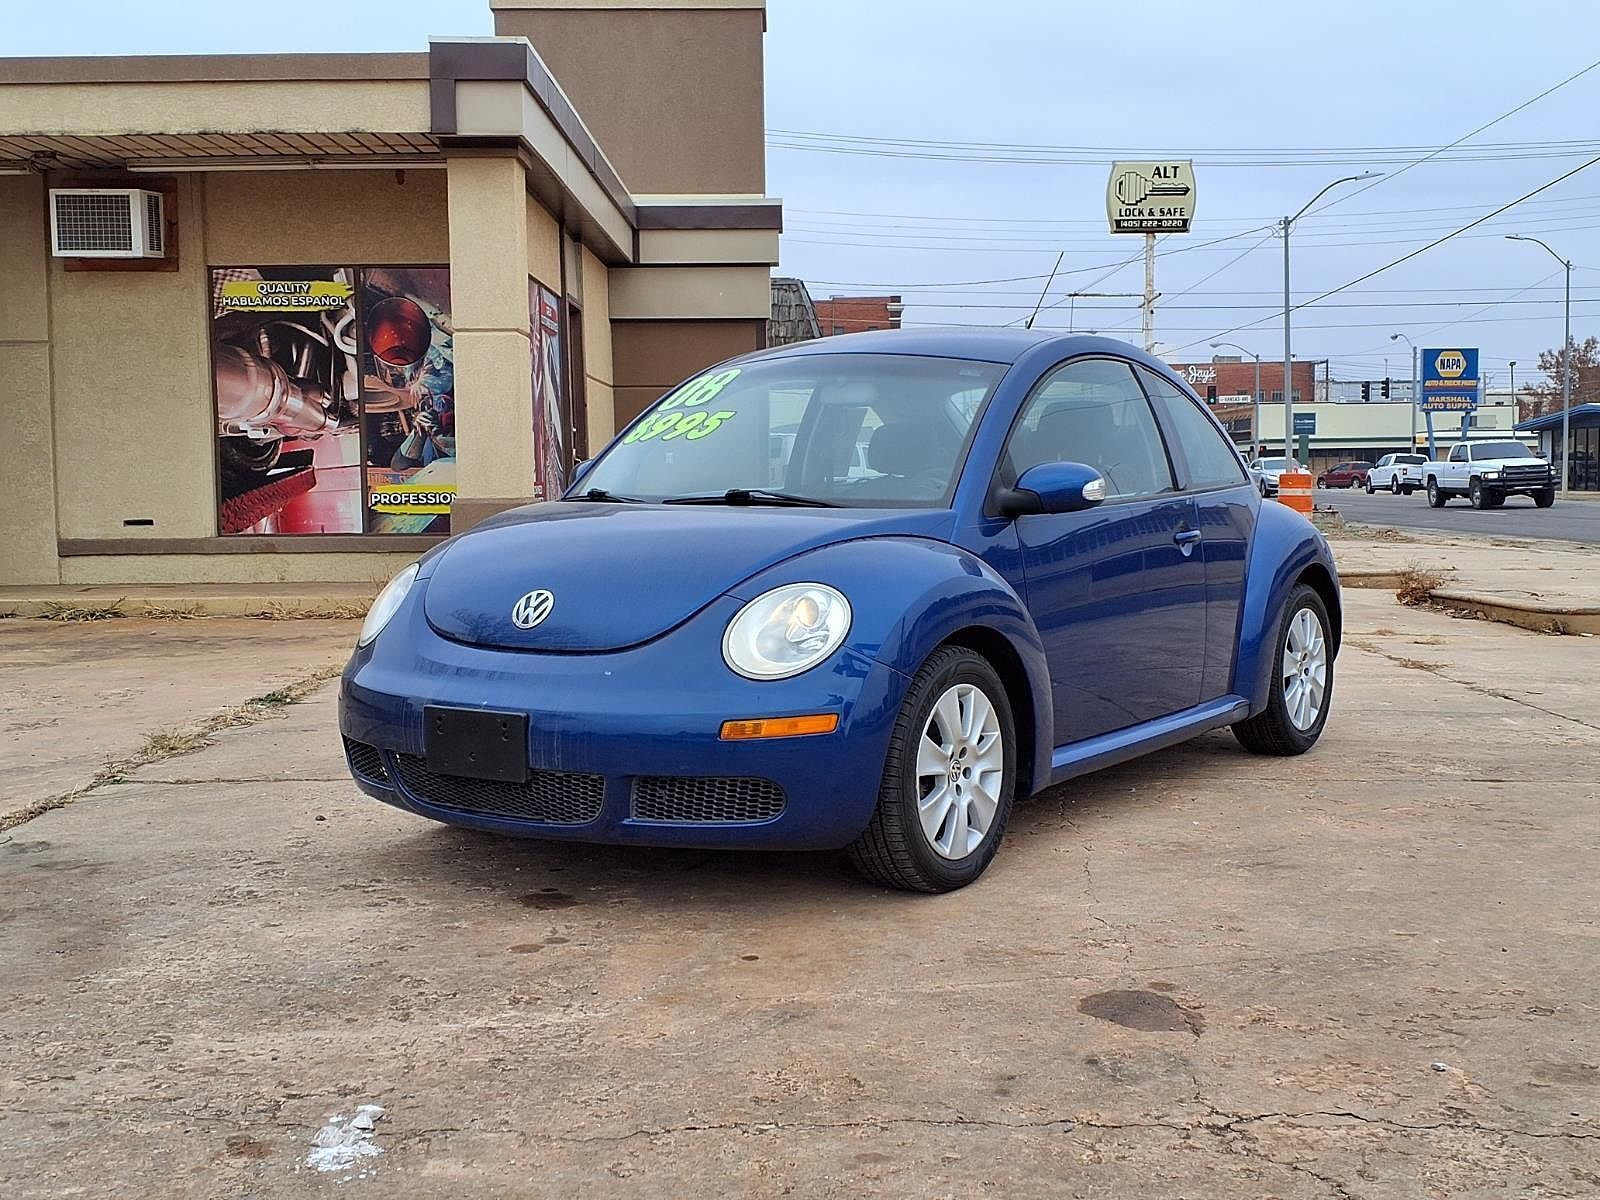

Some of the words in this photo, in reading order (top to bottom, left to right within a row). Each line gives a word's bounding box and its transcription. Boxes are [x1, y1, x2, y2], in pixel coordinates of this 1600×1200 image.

[1151, 166, 1180, 179] ALT
[1119, 207, 1145, 217] LOCK
[1147, 207, 1156, 217] &
[1159, 207, 1185, 217] SAFE
[1142, 220, 1183, 228] 222-0220
[257, 283, 310, 294] QUALITY
[222, 296, 289, 306] HABLAMOS
[291, 294, 345, 306] ESPAÑOL
[1440, 359, 1461, 370] NAPA
[1188, 365, 1216, 384] Jay's
[512, 589, 555, 630] VW
